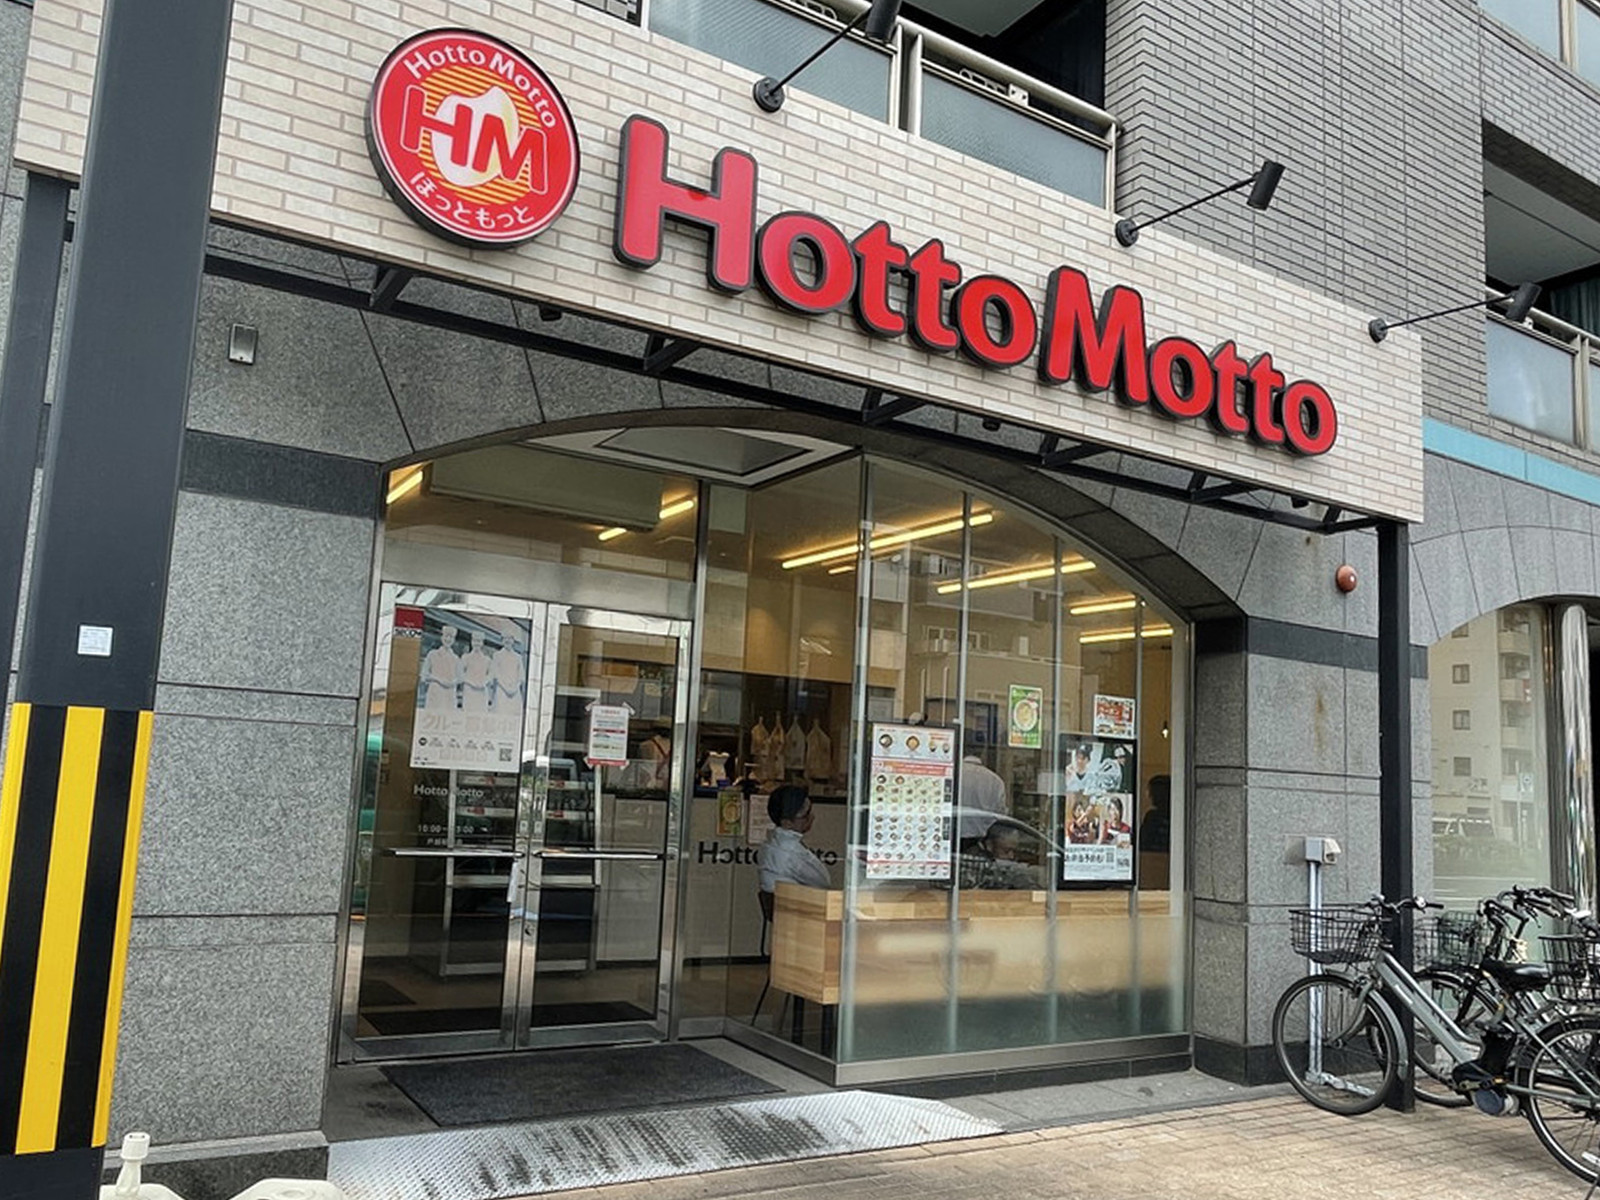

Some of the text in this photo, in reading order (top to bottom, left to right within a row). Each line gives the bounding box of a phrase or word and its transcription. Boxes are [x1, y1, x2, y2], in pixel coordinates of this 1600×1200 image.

[404, 45, 556, 128] Hotto Motto
[401, 84, 548, 195] HM
[410, 171, 535, 229] ほっともっと
[613, 114, 1338, 457] Hotto Motto
[413, 784, 448, 796] Hotto
